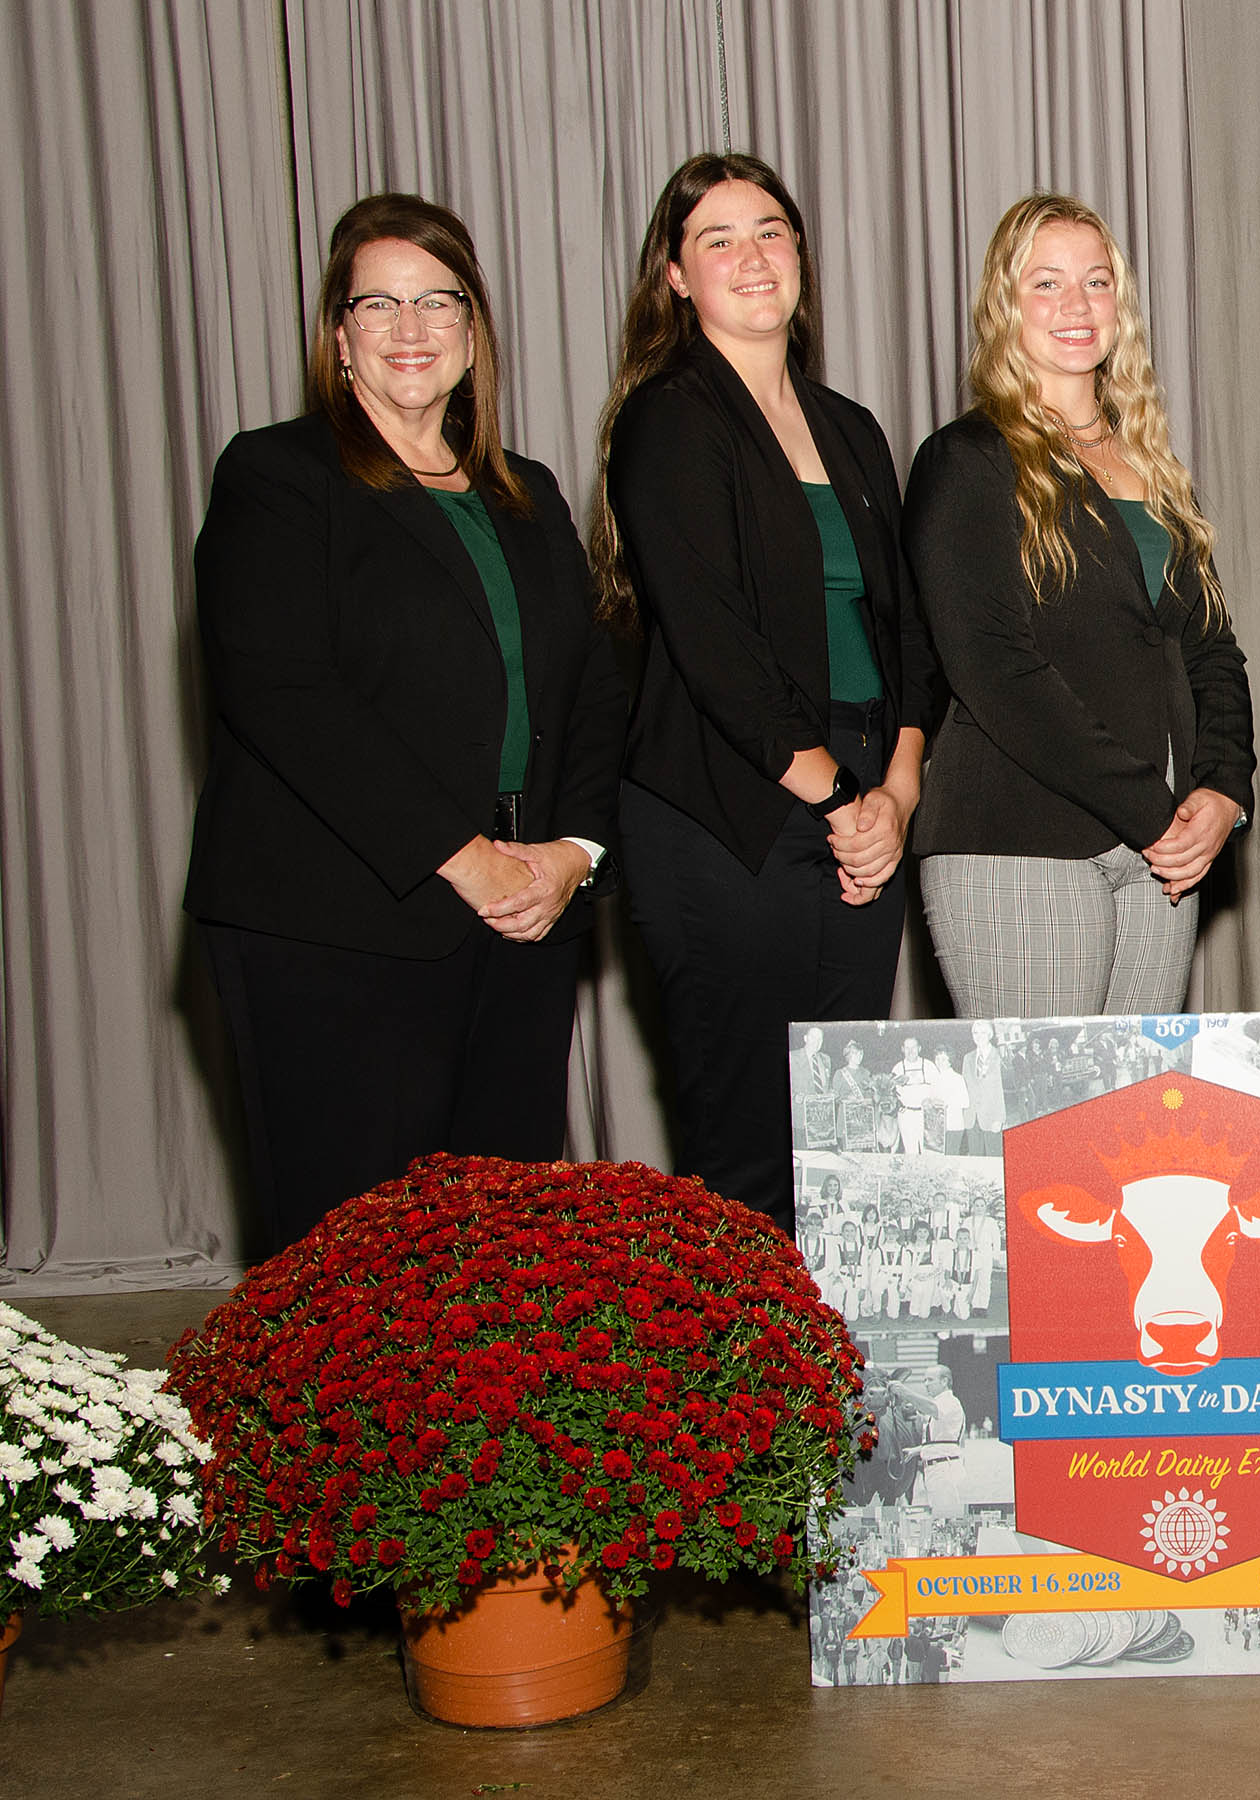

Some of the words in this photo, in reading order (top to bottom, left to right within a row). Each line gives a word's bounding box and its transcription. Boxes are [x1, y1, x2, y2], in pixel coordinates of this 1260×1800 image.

[1012, 1384, 1198, 1417] DYNASTY
[1199, 1390, 1219, 1408] in
[1068, 1449, 1151, 1479] World
[1156, 1449, 1232, 1490] Dairy
[916, 1575, 1022, 1596] OCTOBER
